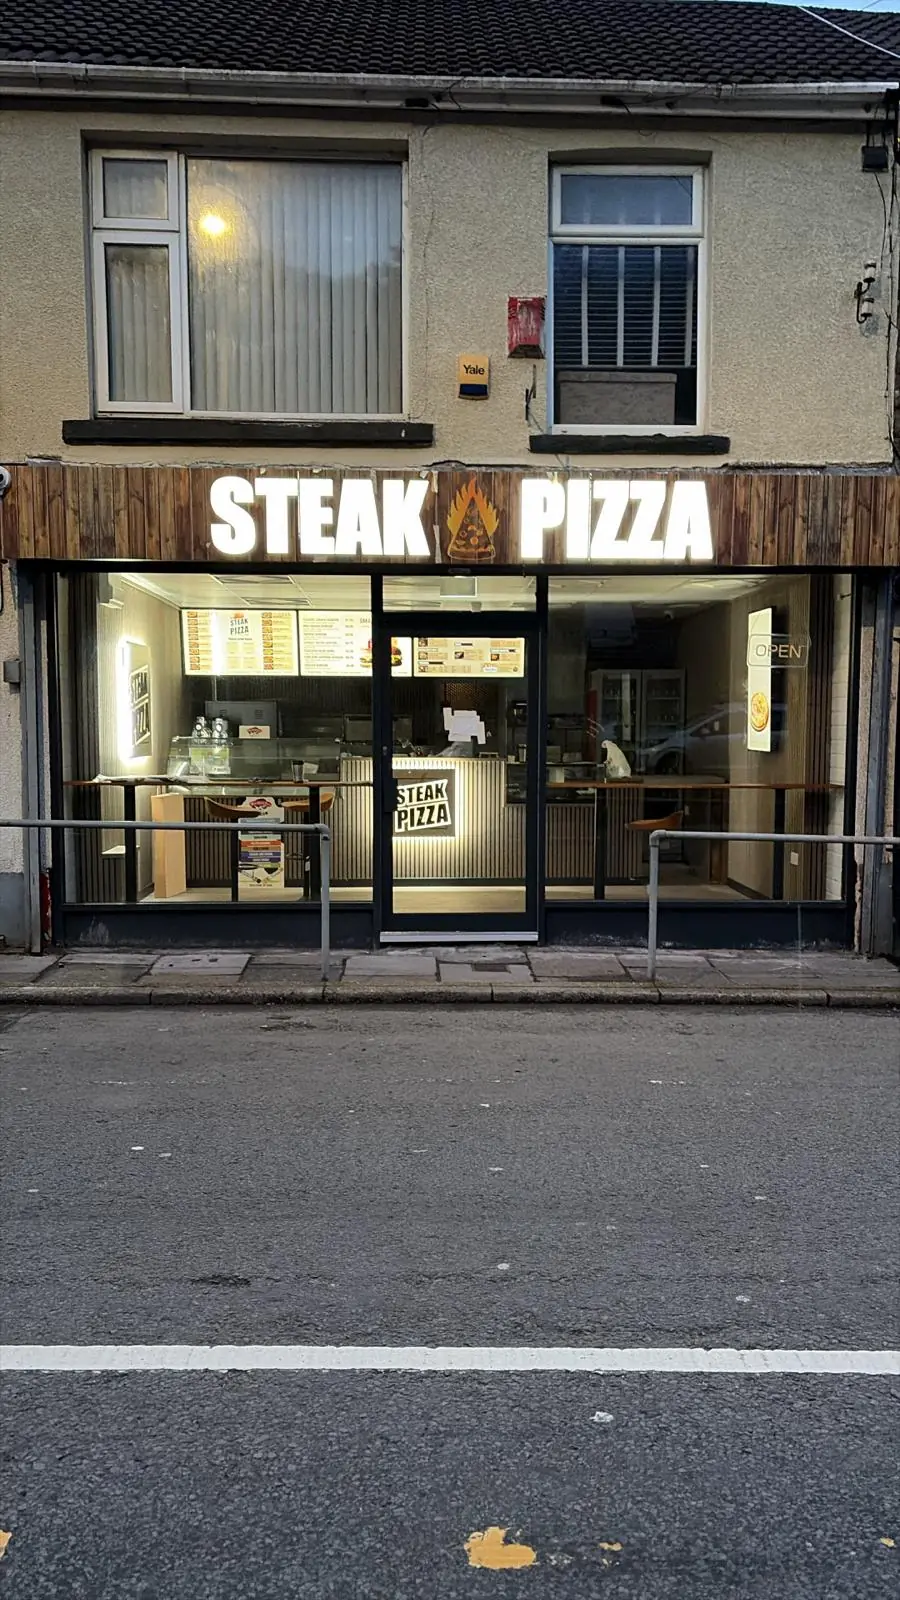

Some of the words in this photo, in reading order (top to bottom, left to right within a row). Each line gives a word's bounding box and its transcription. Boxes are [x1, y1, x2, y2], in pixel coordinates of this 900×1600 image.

[463, 364, 485, 375] Yale
[210, 476, 431, 556] STEAK
[521, 478, 714, 560] PIZZA
[230, 618, 249, 627] STEAK
[230, 626, 249, 635] PIZZA
[755, 643, 802, 659] OPEN
[397, 782, 445, 806] STEAK
[397, 803, 449, 830] PIZZA
